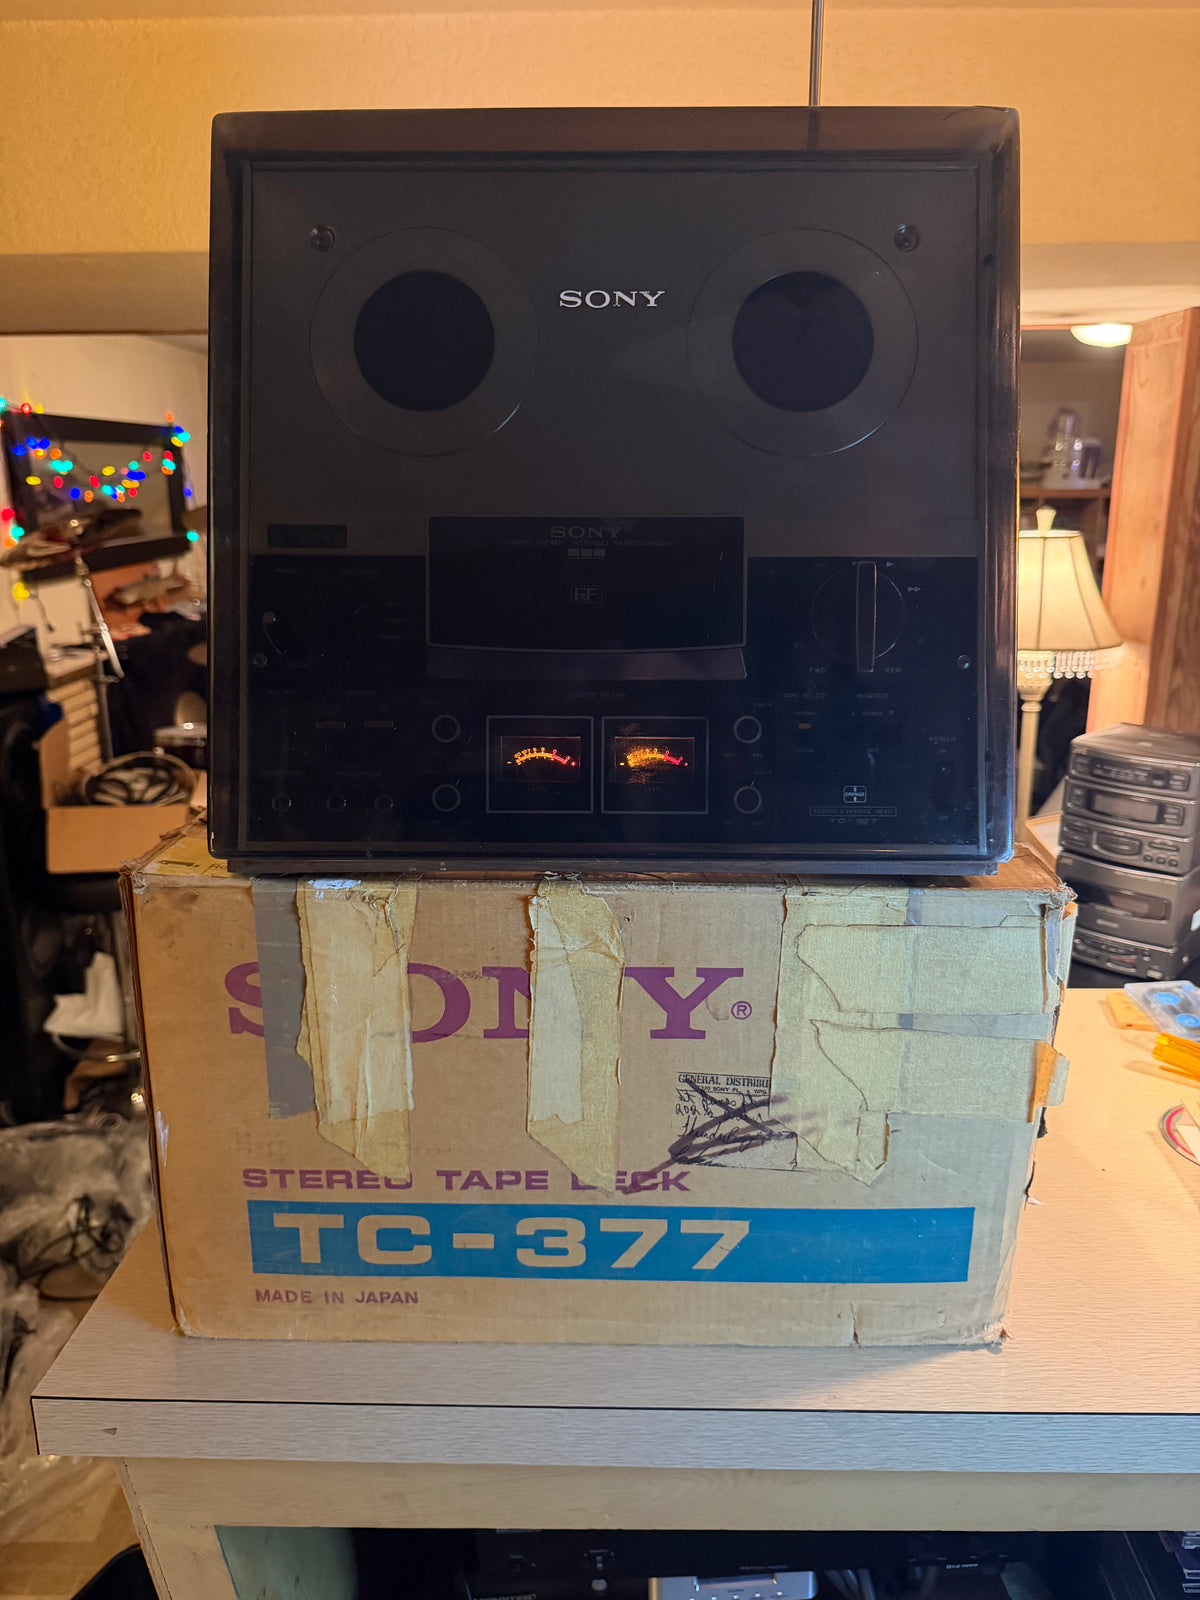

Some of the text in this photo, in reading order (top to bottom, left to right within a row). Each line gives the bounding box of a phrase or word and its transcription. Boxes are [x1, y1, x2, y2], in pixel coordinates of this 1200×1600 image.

[559, 290, 665, 309] SONY
[550, 526, 623, 540] SONY
[678, 1073, 721, 1086] GENERAL
[242, 1168, 413, 1190] STEREO
[436, 1169, 549, 1191] TAPE
[273, 1213, 750, 1270] TC-377
[255, 1289, 419, 1304] MADE IN JAPAN
